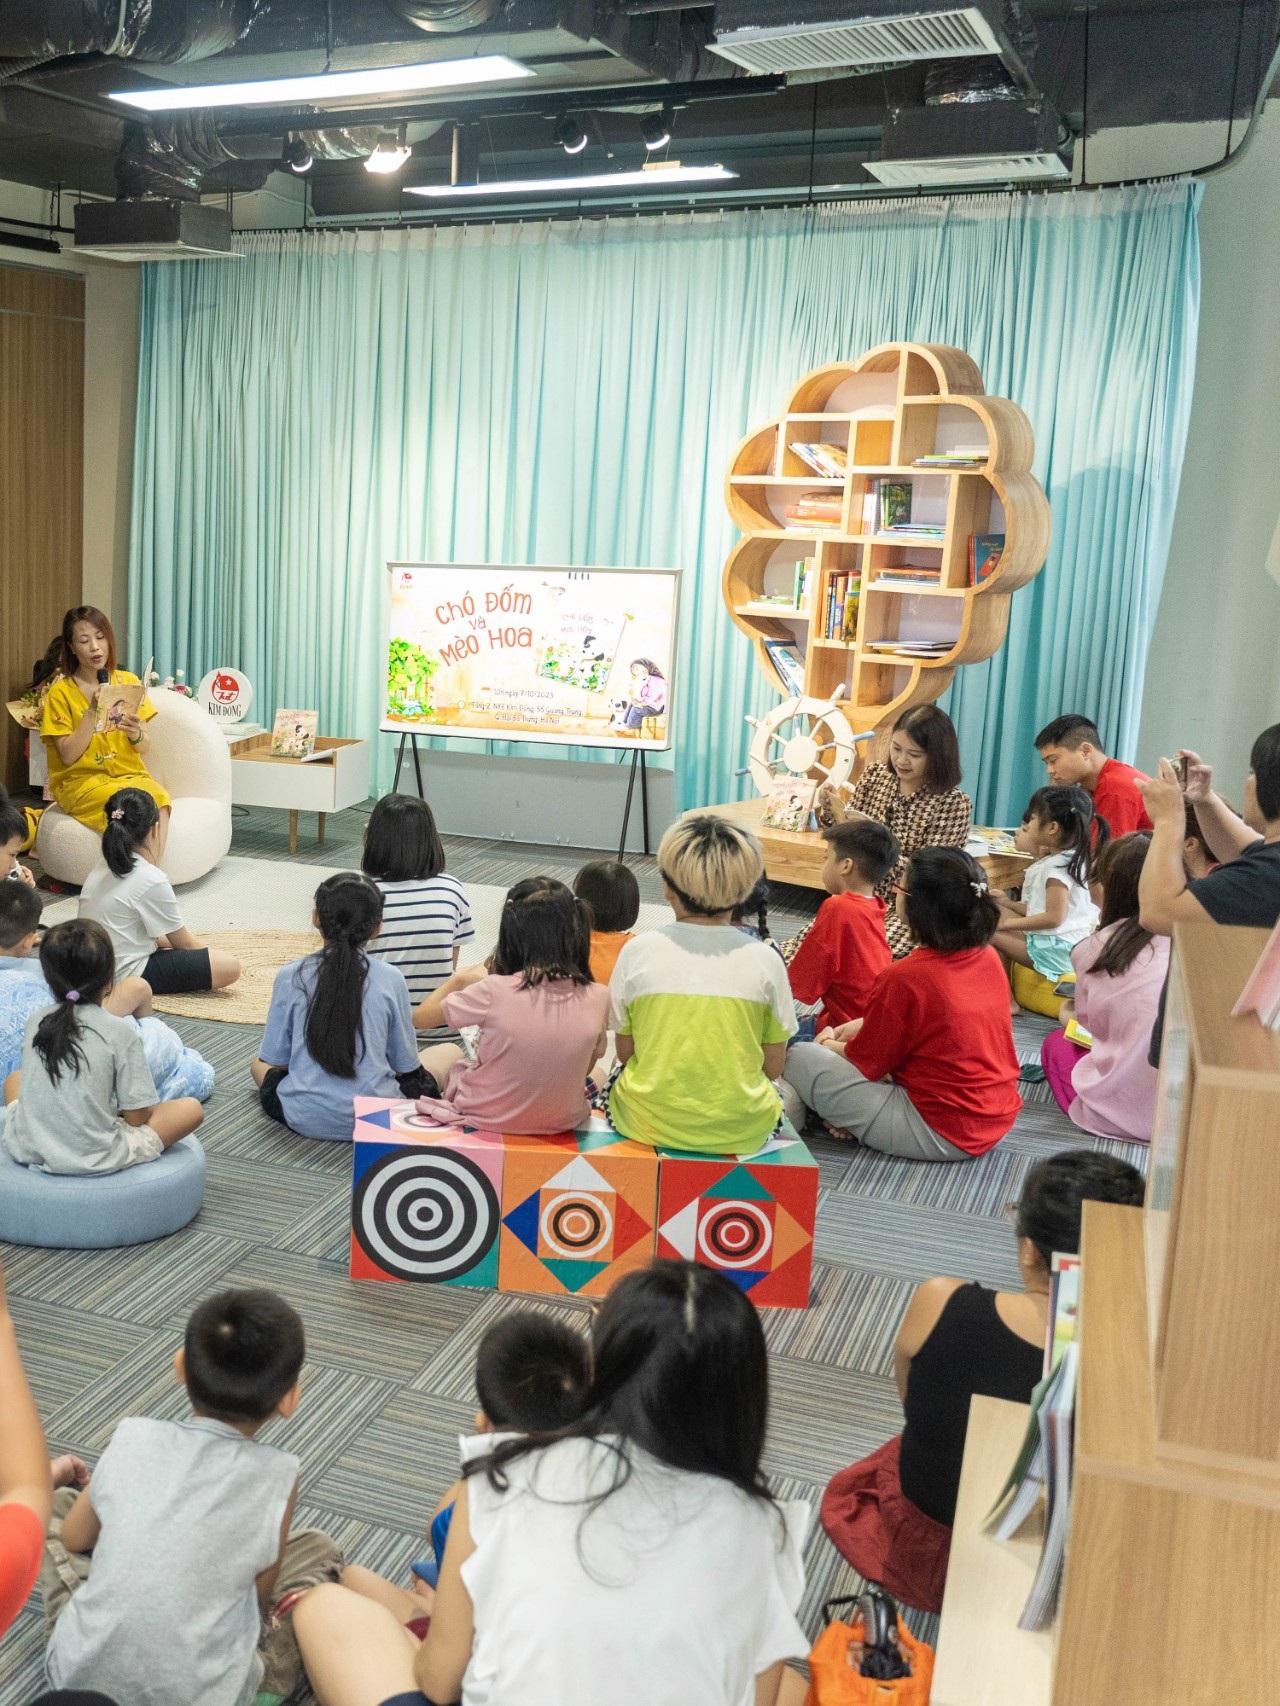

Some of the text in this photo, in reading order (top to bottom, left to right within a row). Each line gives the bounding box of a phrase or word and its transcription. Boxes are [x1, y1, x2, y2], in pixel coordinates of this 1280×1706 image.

[435, 583, 532, 625] Chó Đốm
[468, 615, 487, 631] và
[438, 627, 533, 667] Mèo Hoa
[208, 701, 222, 716] KIM
